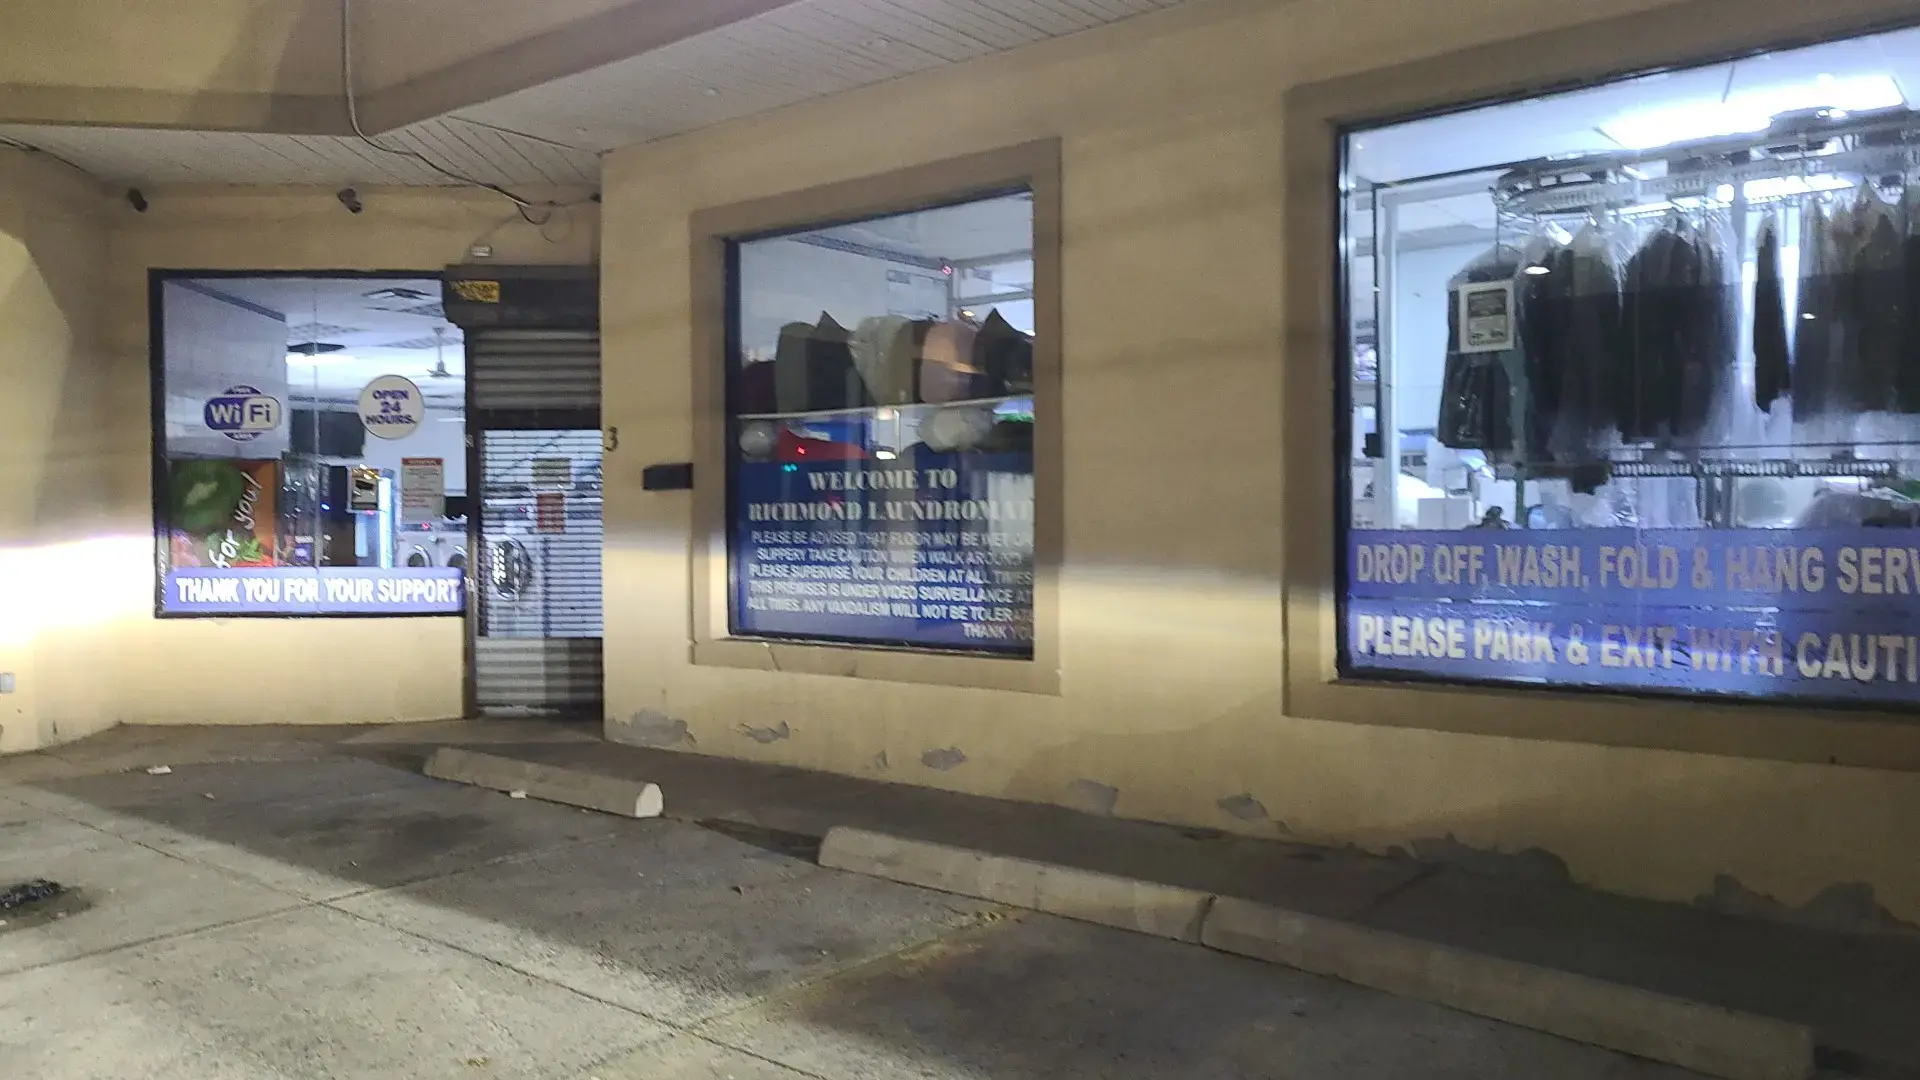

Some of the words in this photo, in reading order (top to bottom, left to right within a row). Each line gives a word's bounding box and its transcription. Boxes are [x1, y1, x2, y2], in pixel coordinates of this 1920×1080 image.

[372, 390, 410, 400] OPEN
[380, 401, 402, 413] 24
[604, 426, 619, 452] 3
[807, 471, 919, 490] WELCOME
[923, 468, 958, 489] TO
[748, 502, 862, 521] RICHMOND
[751, 531, 790, 545] PLEASE
[791, 531, 809, 545] BE
[810, 531, 857, 545] ADVISED
[889, 531, 931, 546] FLOOR
[932, 531, 957, 546] MAY
[960, 532, 979, 546] BE
[981, 532, 1010, 547] WET
[757, 547, 806, 561] SLIPPERY
[807, 547, 837, 562] TAKE
[838, 547, 888, 563] CAUTION
[929, 551, 965, 565] WALK
[749, 563, 790, 578] PLEASE
[790, 564, 851, 580] SUPERVISE
[851, 566, 885, 580] YOUR
[885, 566, 947, 583] CHILDREN
[947, 568, 966, 584] AT
[966, 569, 991, 584] ALL
[1356, 544, 1425, 585] DROP
[1497, 543, 1590, 592] WASH,
[1599, 545, 1679, 590] FOLD
[1691, 547, 1714, 591] &
[1725, 546, 1826, 593] HANG
[175, 577, 240, 603] THANK
[241, 577, 281, 603] YOU
[283, 577, 320, 603] FOR
[324, 577, 375, 603] YOUR
[377, 577, 461, 603] SUPPORT
[749, 580, 774, 594] THIS
[828, 582, 840, 597] IS
[841, 583, 881, 598] UNDER
[880, 584, 918, 600] VIDEO
[918, 585, 1014, 603] SURVEILLANCE
[746, 596, 767, 610] ALL
[801, 599, 826, 613] ANY
[826, 600, 891, 617] VANDALISM
[891, 603, 922, 618] WILL
[922, 604, 949, 620] NOT
[949, 605, 969, 621] BE
[962, 622, 1008, 639] THANK
[1357, 613, 1467, 659] PLEASE
[1473, 616, 1557, 665] PARK
[1567, 623, 1590, 667] &
[1600, 623, 1677, 670] EXIT
[1688, 626, 1784, 677] WITH
[1796, 630, 1918, 683] CAUTI
